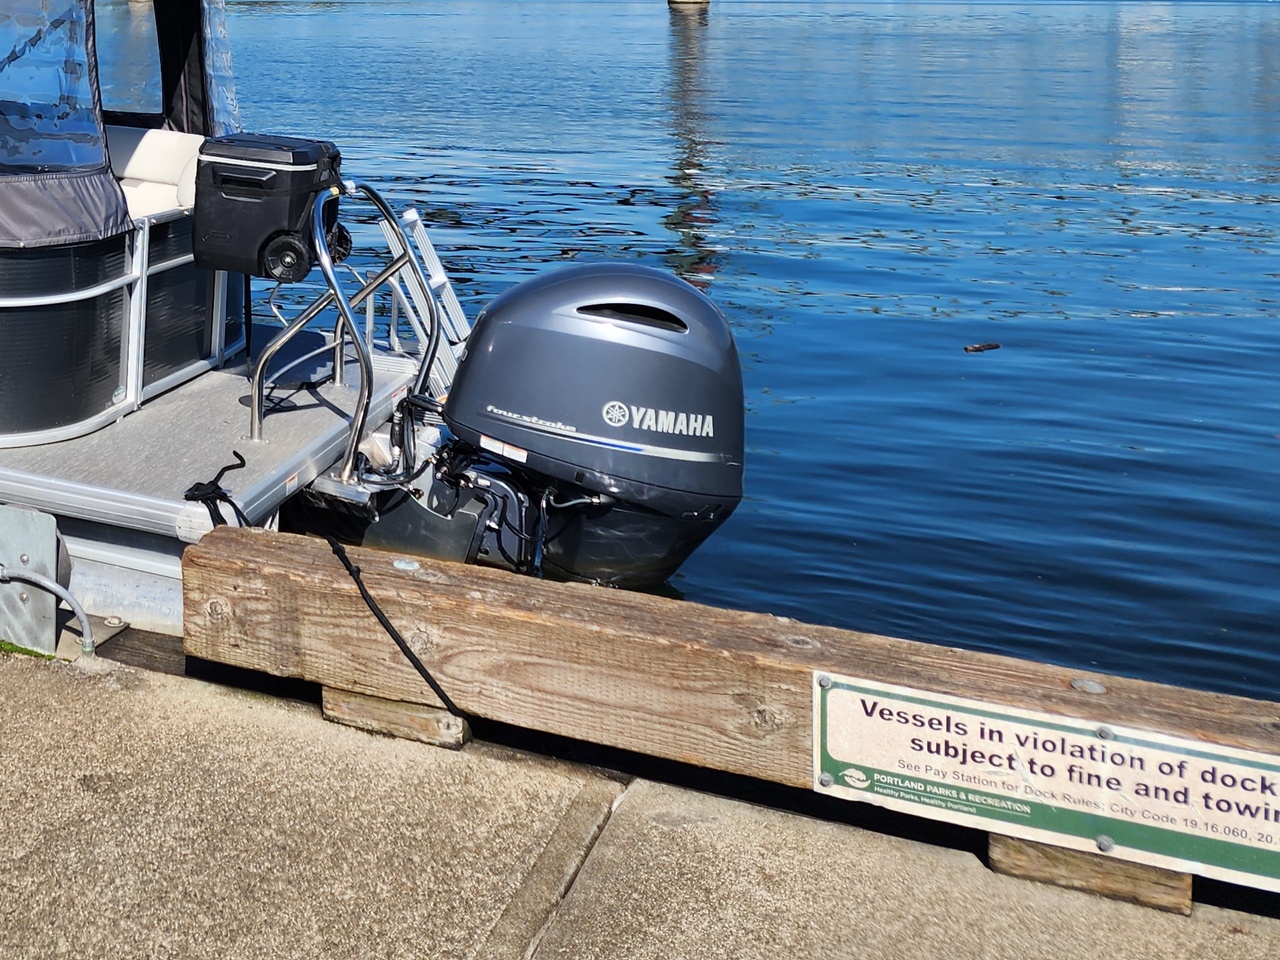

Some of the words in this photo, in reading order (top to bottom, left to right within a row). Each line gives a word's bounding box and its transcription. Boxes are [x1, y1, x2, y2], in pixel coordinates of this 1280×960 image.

[630, 405, 714, 437] YAMAHA
[860, 698, 968, 736] Vessels
[979, 722, 1004, 743] in
[1015, 732, 1145, 771] violation
[1158, 760, 1188, 779] of
[1200, 766, 1278, 797] dock
[910, 737, 1016, 771] subject
[1028, 758, 1055, 777] to
[1067, 765, 1121, 790] fine
[1134, 782, 1189, 806] and
[874, 773, 925, 791] PORTLAND
[926, 784, 958, 799] PARKS
[959, 791, 967, 801] &
[968, 793, 1032, 814] RECREATION
[874, 785, 900, 798] Healthy
[920, 796, 947, 808] Healthy
[947, 800, 977, 814] Portland
[898, 759, 921, 772] See
[925, 764, 948, 779] Pay
[952, 770, 998, 788] Station
[1002, 780, 1020, 792] for
[1024, 785, 1058, 801] Dock
[1110, 802, 1137, 818] City
[1141, 809, 1178, 825] Code
[1182, 818, 1253, 842] 19.16.060,
[1257, 832, 1280, 846] 20.
